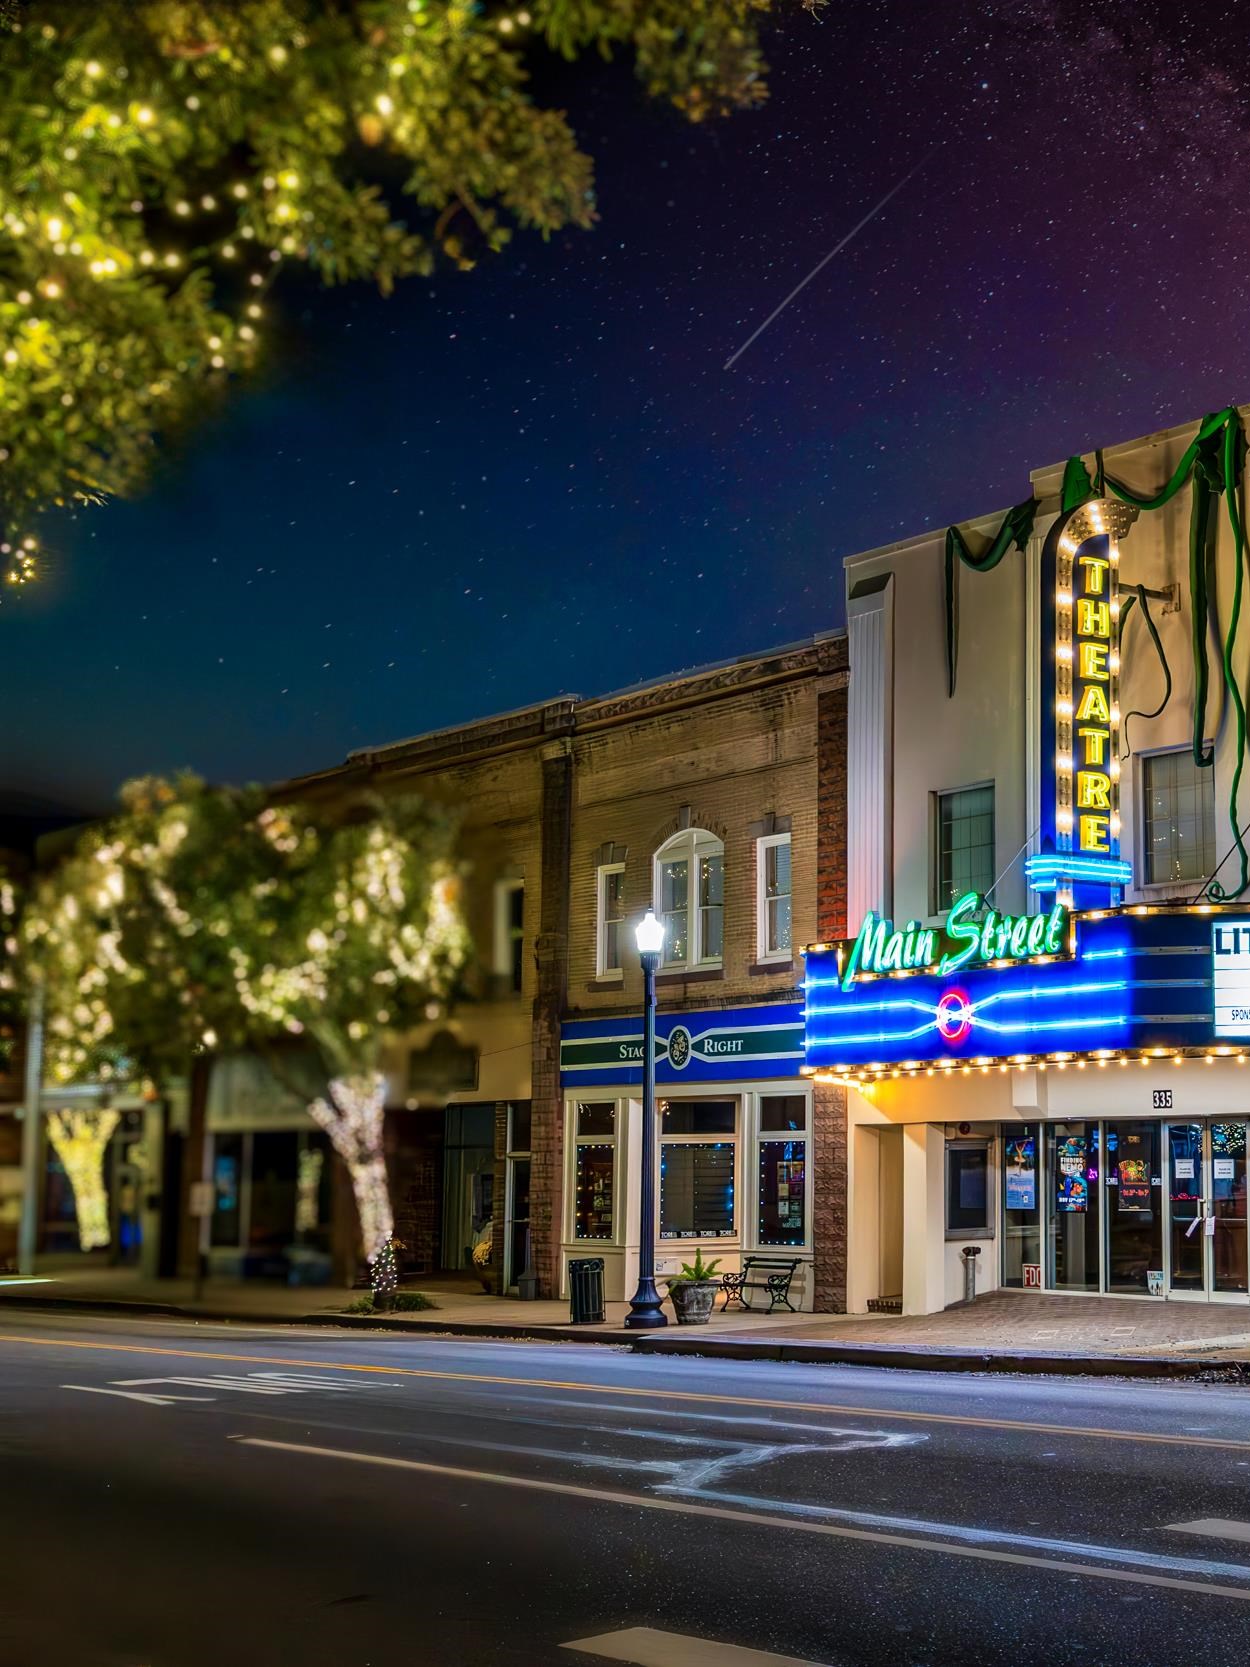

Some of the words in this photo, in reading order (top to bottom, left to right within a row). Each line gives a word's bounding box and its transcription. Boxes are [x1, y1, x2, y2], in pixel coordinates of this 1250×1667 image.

[1075, 556, 1111, 854] THEATRE
[842, 911, 936, 991] Main
[938, 892, 1063, 976] Street
[703, 1039, 744, 1053] RIGHT
[1153, 1091, 1172, 1107] 335
